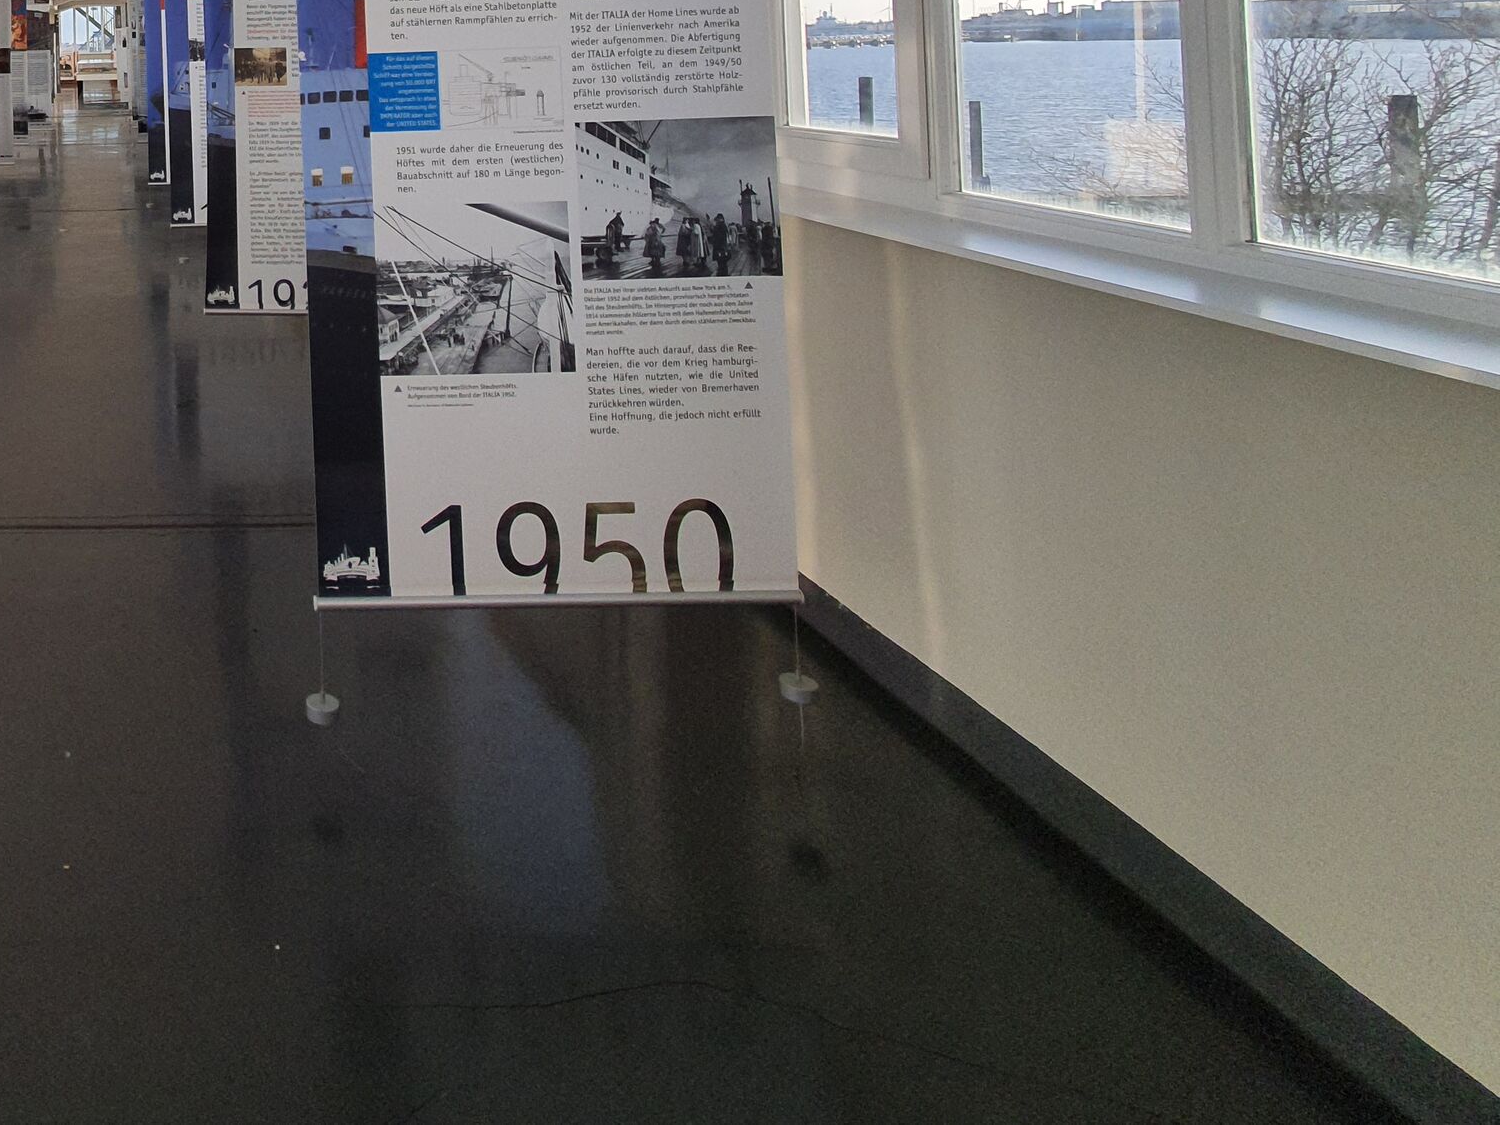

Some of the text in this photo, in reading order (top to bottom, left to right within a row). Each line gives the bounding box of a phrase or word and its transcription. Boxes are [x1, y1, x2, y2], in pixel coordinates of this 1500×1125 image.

[569, 5, 741, 20] Mit der ITALIA der Home Lines wurde ab
[390, 32, 408, 41] ten.
[573, 99, 640, 110] ersetzt wurden.
[396, 141, 563, 155] 1951 wurde daher die Erneuerung des
[248, 278, 309, 310] 19
[589, 408, 761, 423] Eine Hoffnung, die jedoch nicht erfüllt
[589, 425, 620, 435] wurde.
[420, 497, 736, 595] 1950
